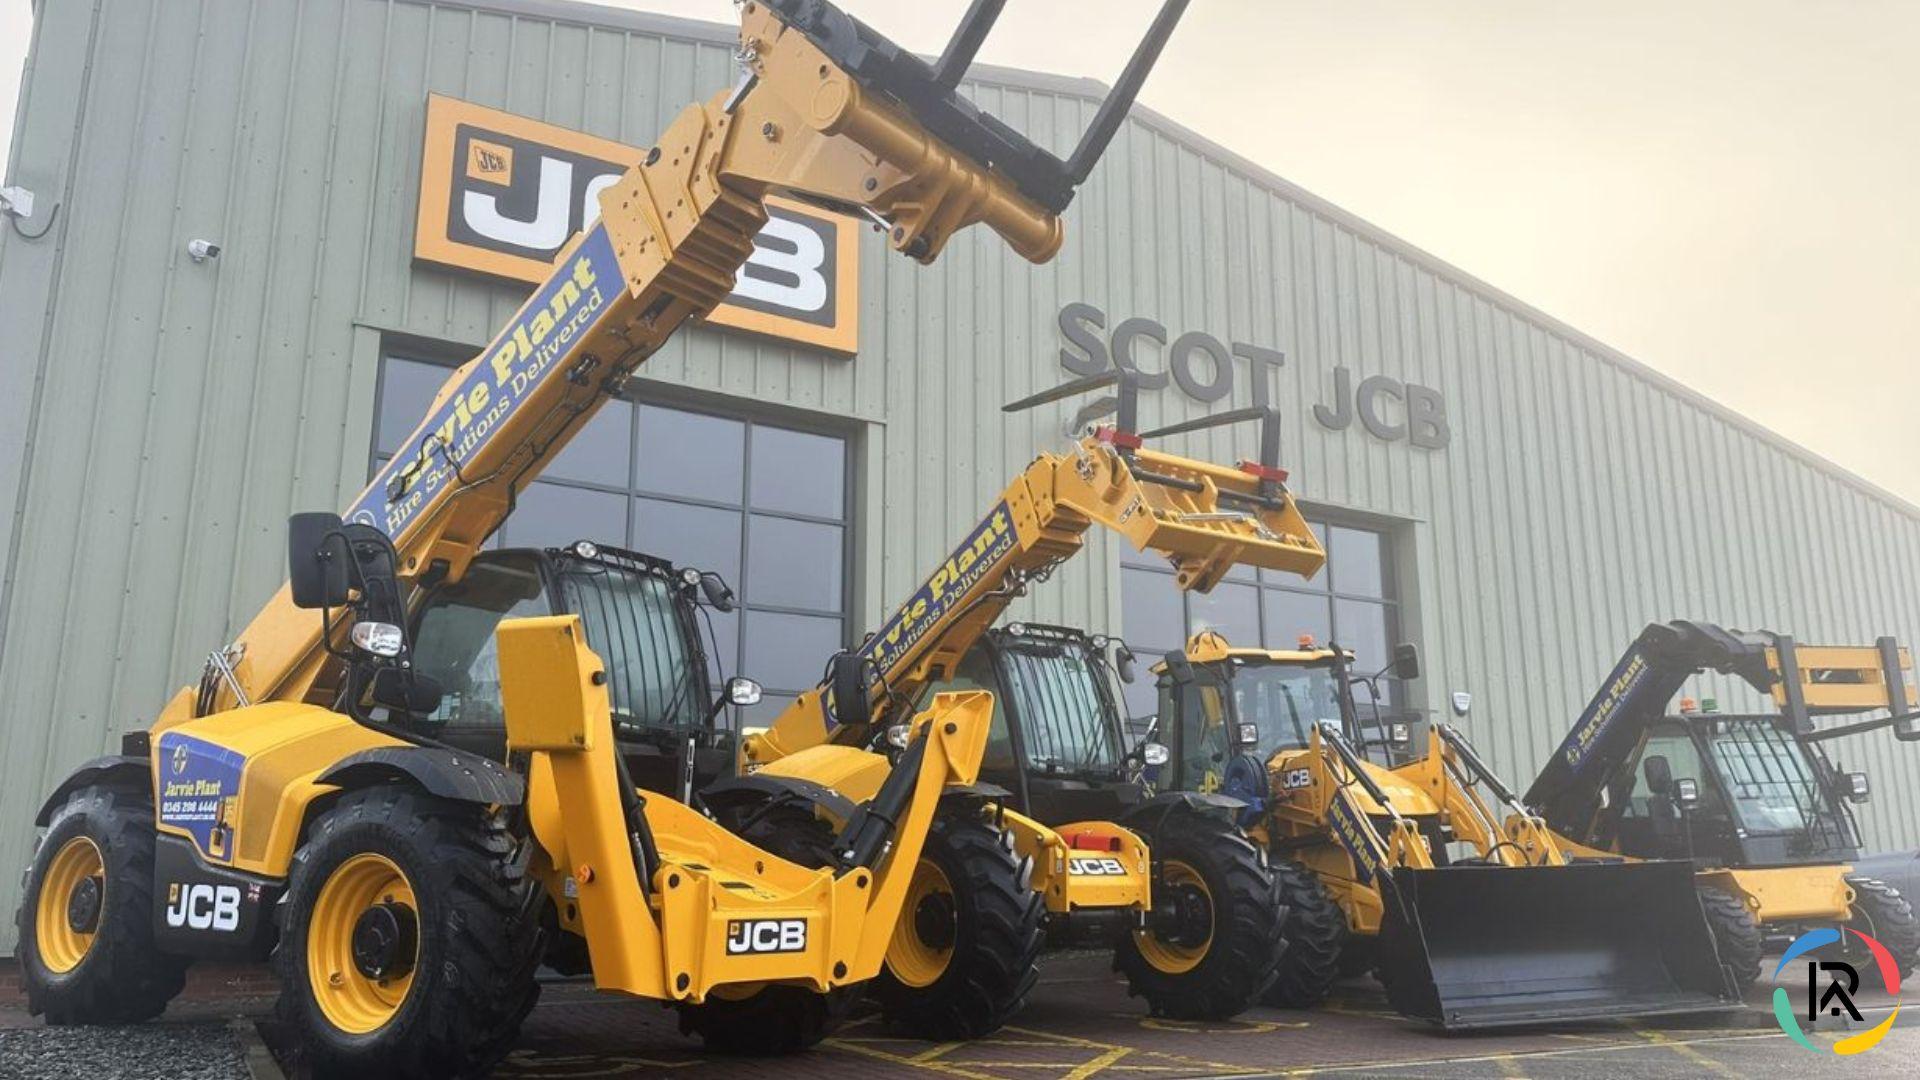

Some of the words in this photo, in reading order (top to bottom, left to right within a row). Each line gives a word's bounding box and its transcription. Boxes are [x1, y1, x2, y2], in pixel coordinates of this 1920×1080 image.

[463, 156, 827, 312] JB
[490, 255, 597, 388] Plant
[386, 491, 422, 535] Hire
[511, 285, 604, 399] Delivered
[1058, 302, 1286, 410] SCOT
[1313, 364, 1451, 450] JCB
[929, 510, 1008, 603] Plant
[943, 532, 1013, 610] Delivered
[1578, 697, 1613, 747] Jarvie
[1609, 653, 1644, 699] Plant
[165, 779, 194, 796] Jarvie
[195, 779, 221, 796] Plant
[1283, 769, 1310, 788] JCB
[167, 884, 241, 932] JCB
[1069, 859, 1125, 875] JCB
[728, 920, 805, 953] JCB
